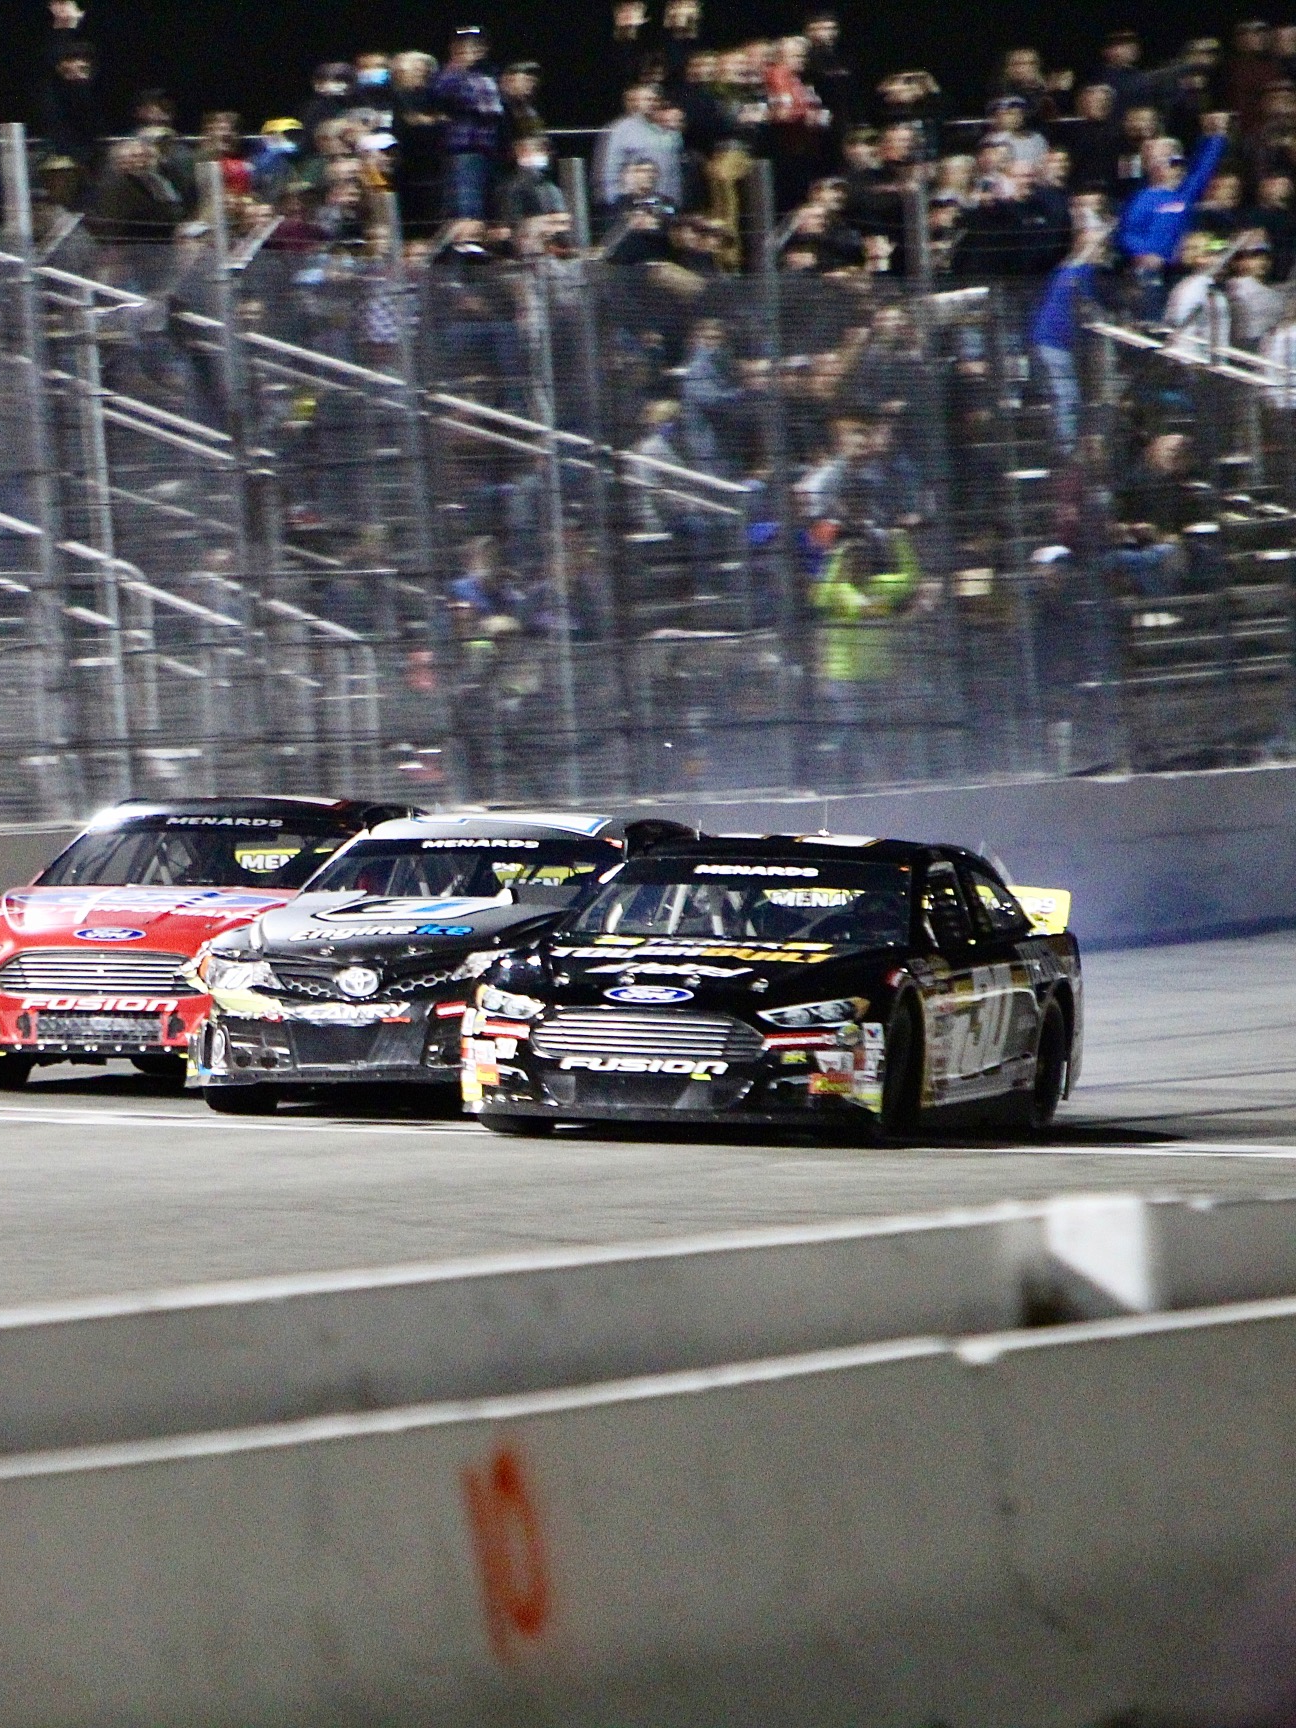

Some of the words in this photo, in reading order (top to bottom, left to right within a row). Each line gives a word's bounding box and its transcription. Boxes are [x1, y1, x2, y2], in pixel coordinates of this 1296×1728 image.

[166, 816, 283, 828] MENARDS
[421, 839, 540, 849] MENARDS
[694, 864, 819, 877] MENARDS
[80, 927, 138, 941] Ford
[618, 987, 681, 1001] Ford
[21, 998, 179, 1012] FUSION
[305, 1002, 410, 1019] CAMRY
[560, 1057, 729, 1075] FUSION
